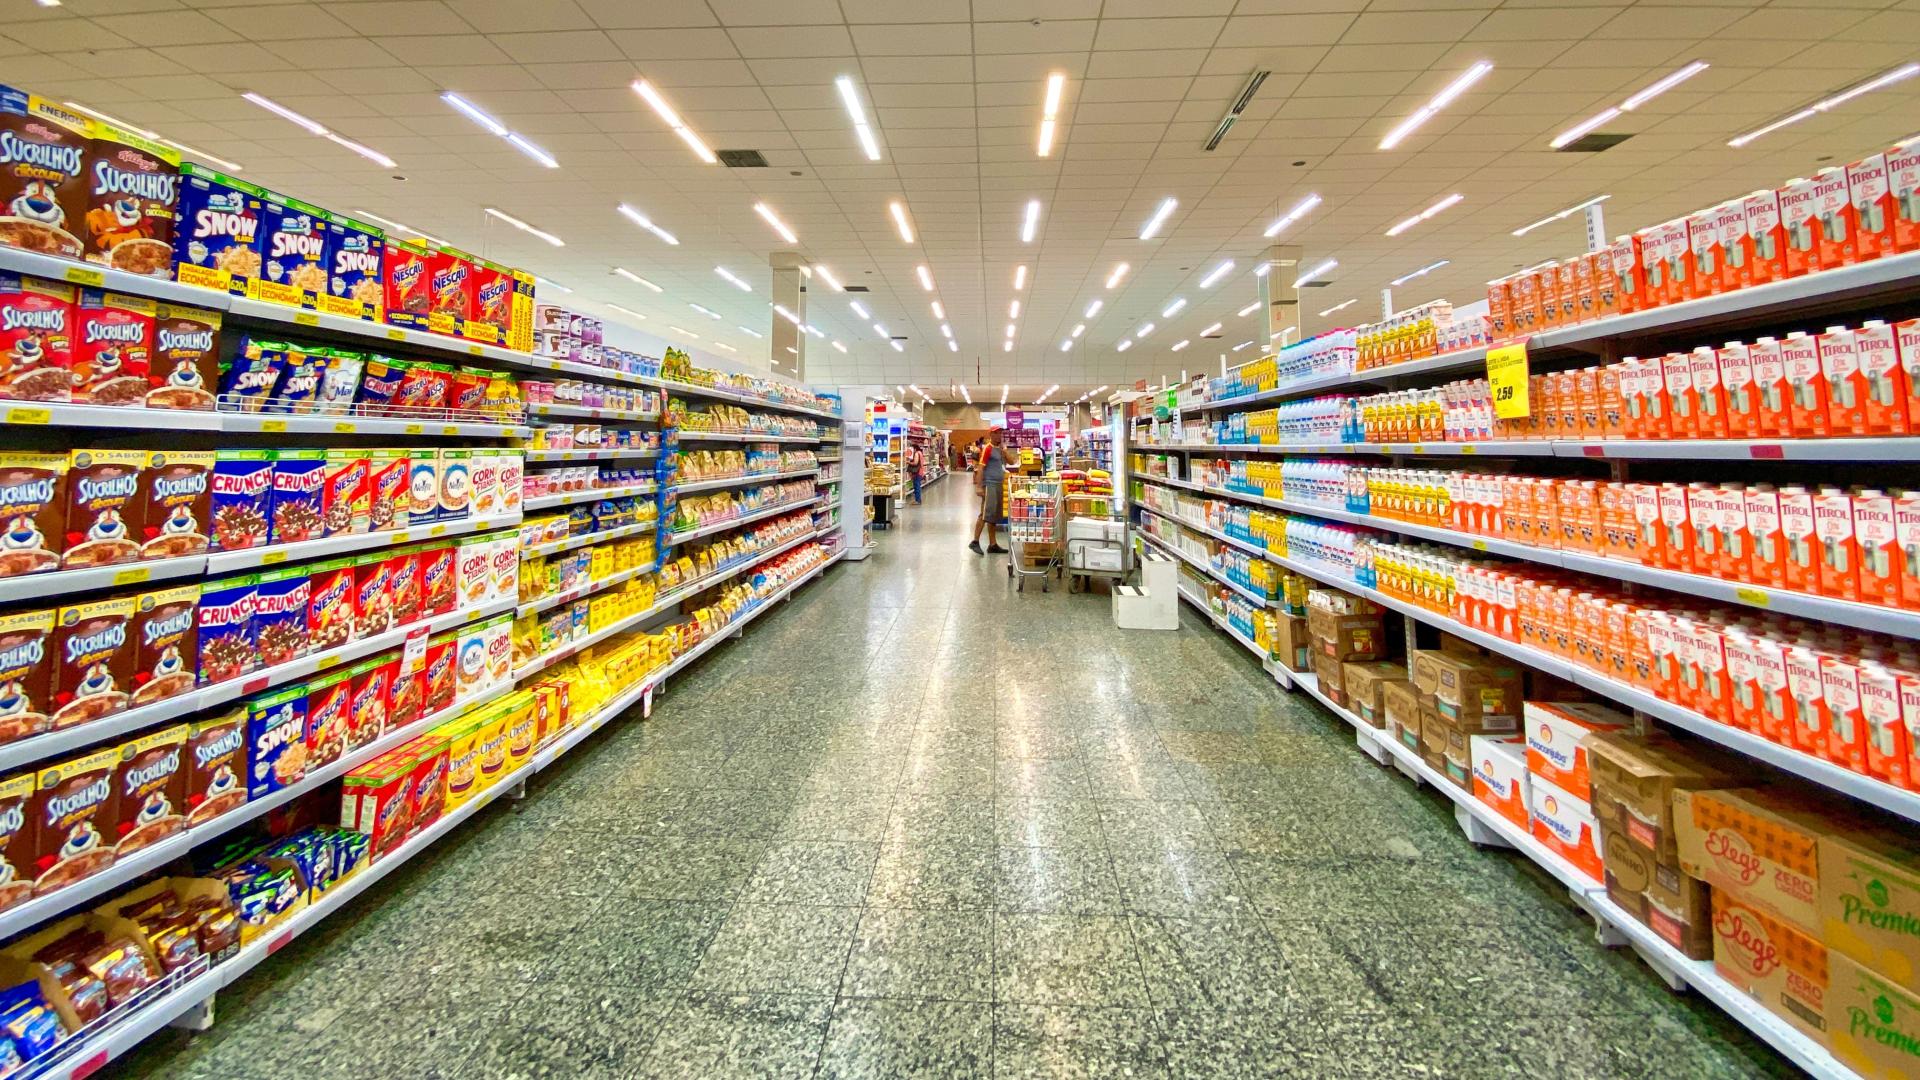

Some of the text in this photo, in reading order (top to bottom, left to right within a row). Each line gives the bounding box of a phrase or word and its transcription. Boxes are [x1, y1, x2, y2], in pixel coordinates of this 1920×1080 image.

[39, 102, 86, 126] ENERGIA
[0, 131, 83, 177] SUCRILHOS
[95, 160, 175, 206] SUCRILHOS
[194, 209, 258, 239] SNOW
[271, 231, 323, 258] SNOW
[335, 250, 380, 274] SNOW
[392, 261, 425, 285] NESCAU
[432, 266, 468, 293] NESCAU
[479, 280, 509, 305] NESCAU
[2, 305, 65, 332] SUCRILHOS
[86, 319, 145, 344] SUCRILHOS
[159, 330, 214, 352] SUCRILHOS
[234, 369, 280, 391] SNOW
[78, 472, 139, 504] SUCRILHOS
[154, 472, 208, 501] SUCRILHOS
[213, 468, 272, 494] CRUNCH
[274, 467, 326, 491] CRUNCH
[334, 465, 366, 494] NESCAU
[378, 464, 407, 490] NESCAU
[472, 466, 495, 484] CORN
[500, 466, 520, 484] CORN
[0, 477, 57, 505] UCRILHOS
[425, 552, 454, 585] NESCAU
[462, 552, 487, 575] CORN
[493, 547, 515, 569] CORN
[257, 583, 311, 615] CRUNCH
[312, 574, 351, 617] NESCAU
[358, 567, 392, 605] NESCAU
[200, 592, 258, 625] CRUNCH
[144, 607, 193, 646] SUCRILHOS
[66, 621, 127, 664] SUCRILHOS
[488, 631, 509, 656] CORN
[427, 645, 455, 683] NESCAU
[351, 674, 384, 718] NESCAU
[310, 687, 348, 735] NESCAU
[195, 727, 244, 769] SUCRILHOS
[256, 715, 305, 761] SNOW
[125, 747, 181, 796] SUCRILHOS
[416, 755, 449, 799] NESCAU
[47, 774, 112, 827] SUCRILHOS
[379, 773, 414, 824] NESCAU
[1774, 870, 1813, 895] ZERO
[1786, 970, 1823, 1001] ZERO
